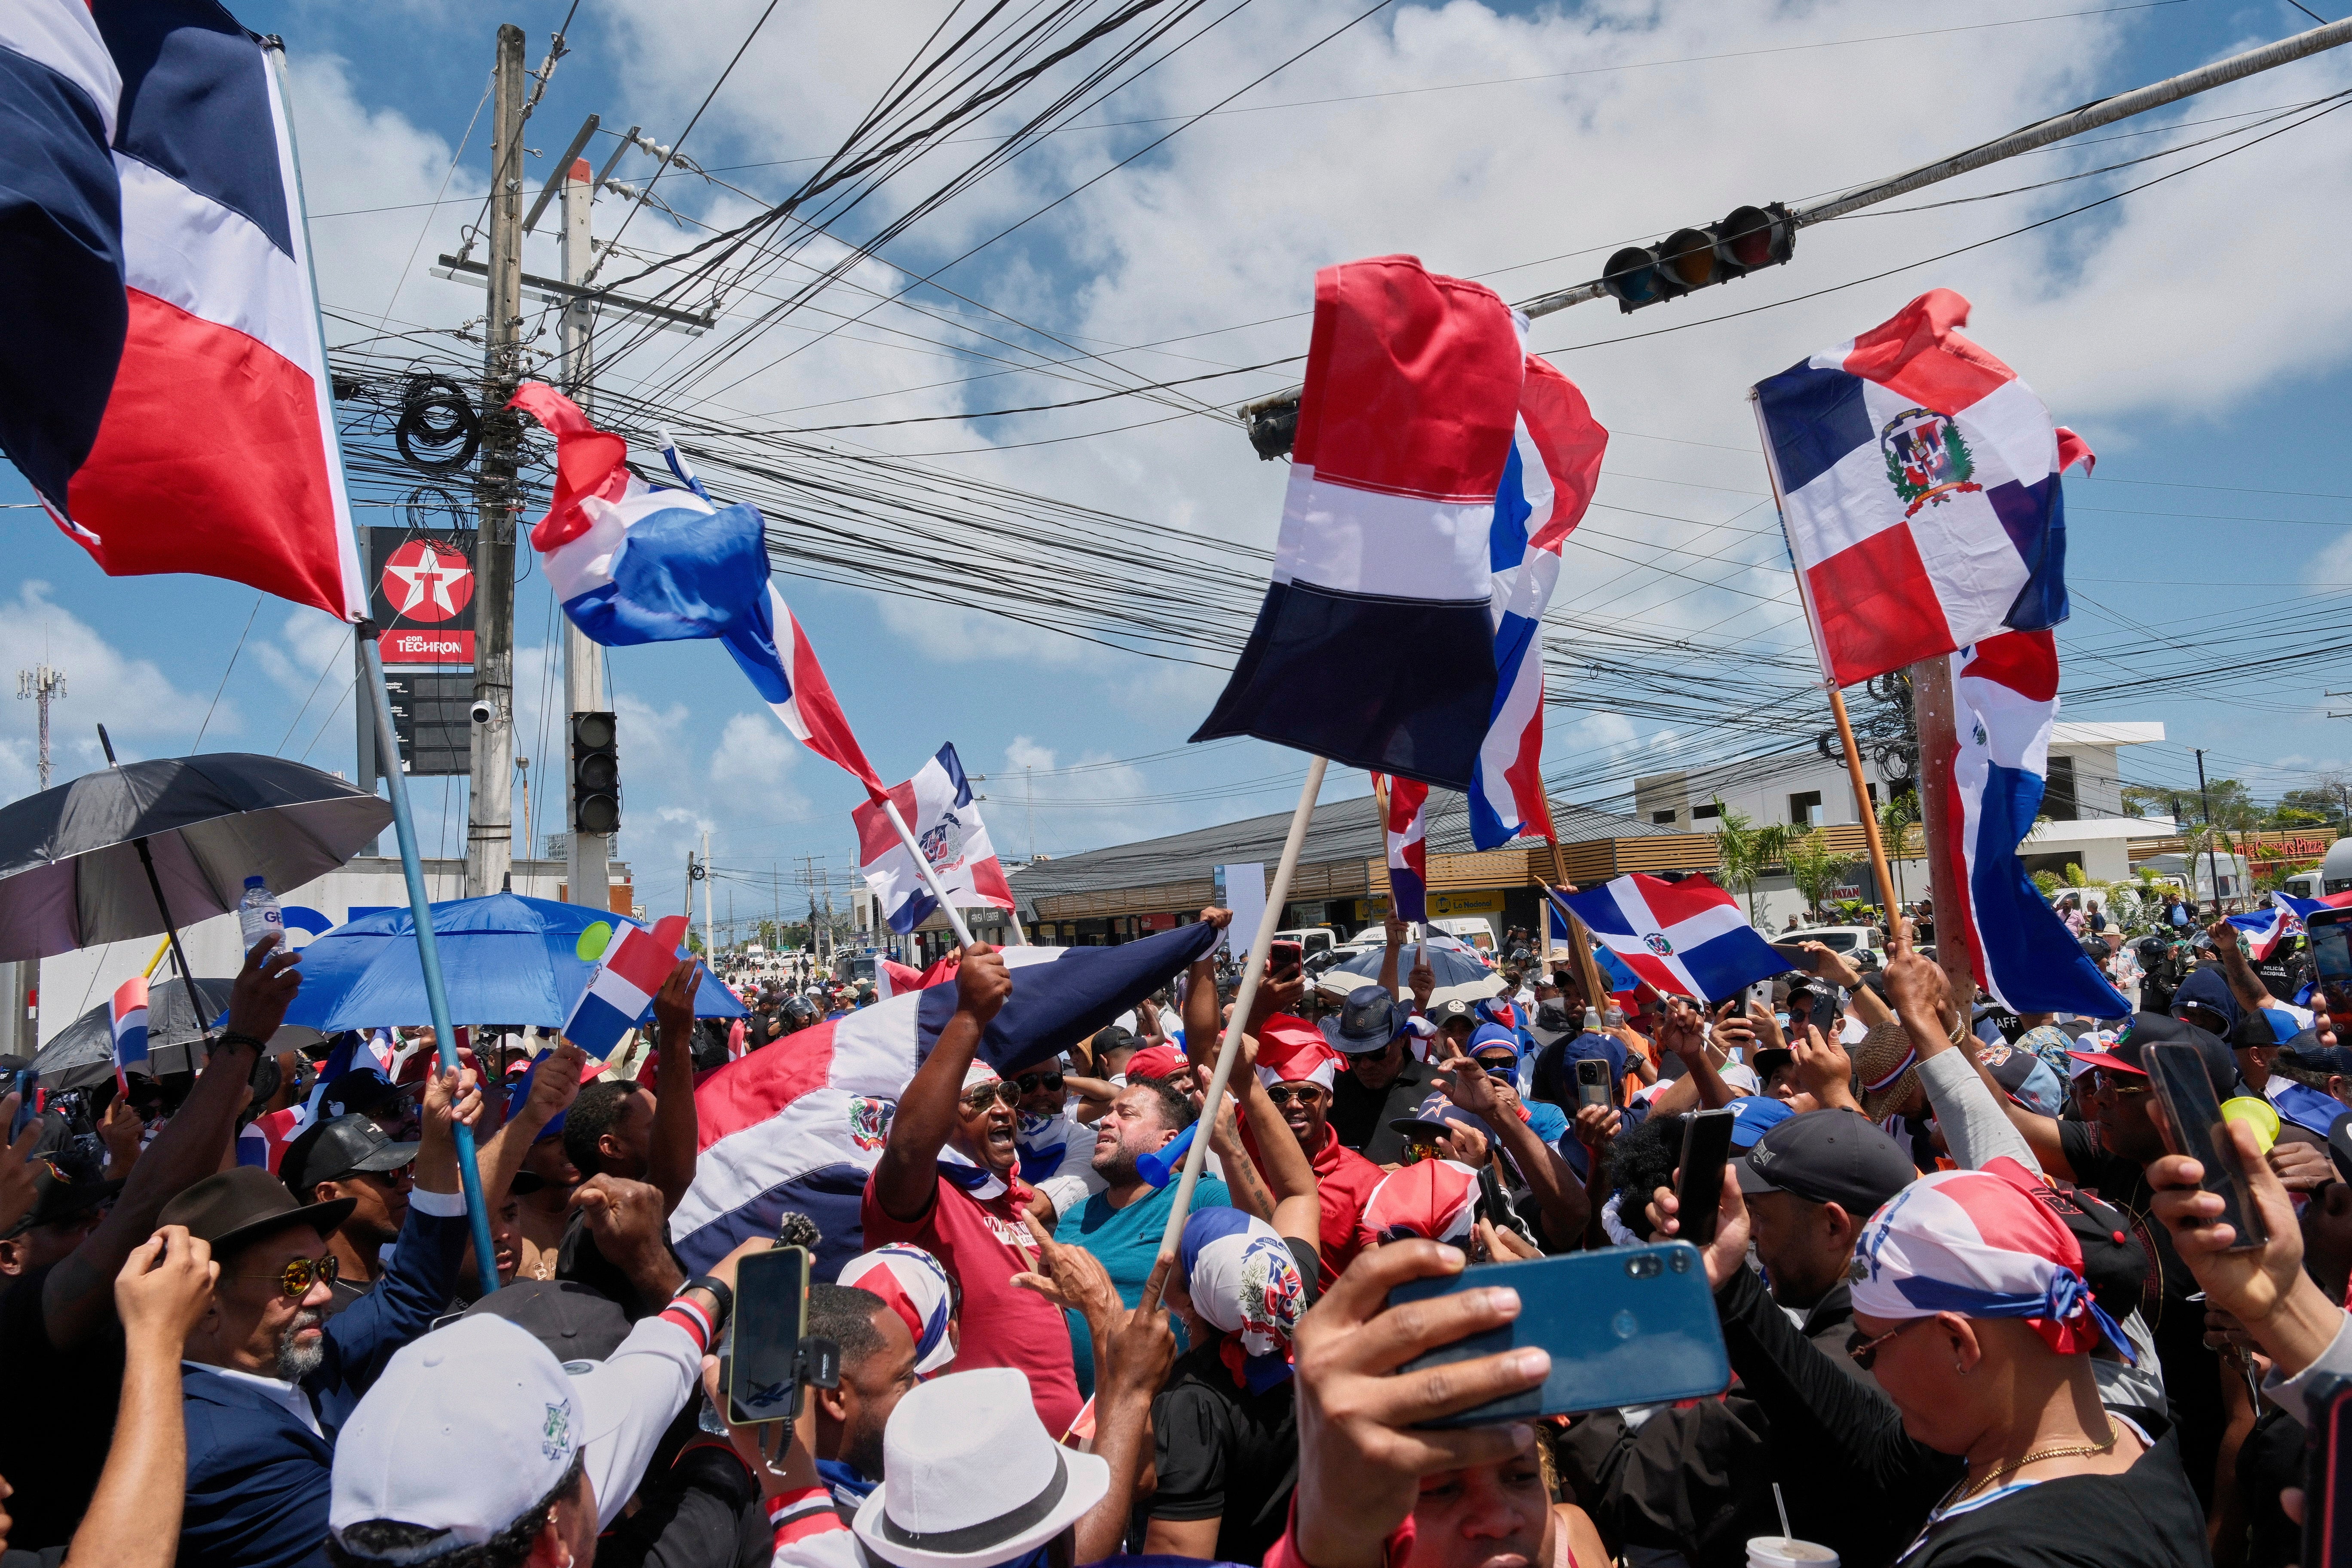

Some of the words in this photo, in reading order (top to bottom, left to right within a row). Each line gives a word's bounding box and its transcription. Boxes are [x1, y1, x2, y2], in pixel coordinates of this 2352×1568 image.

[397, 640, 462, 654] TECHRON
[2295, 837, 2323, 854] Pizza
[1464, 899, 1492, 908] Nacional
[986, 912, 999, 922] CENTER
[1992, 1017, 2017, 1029] AFF
